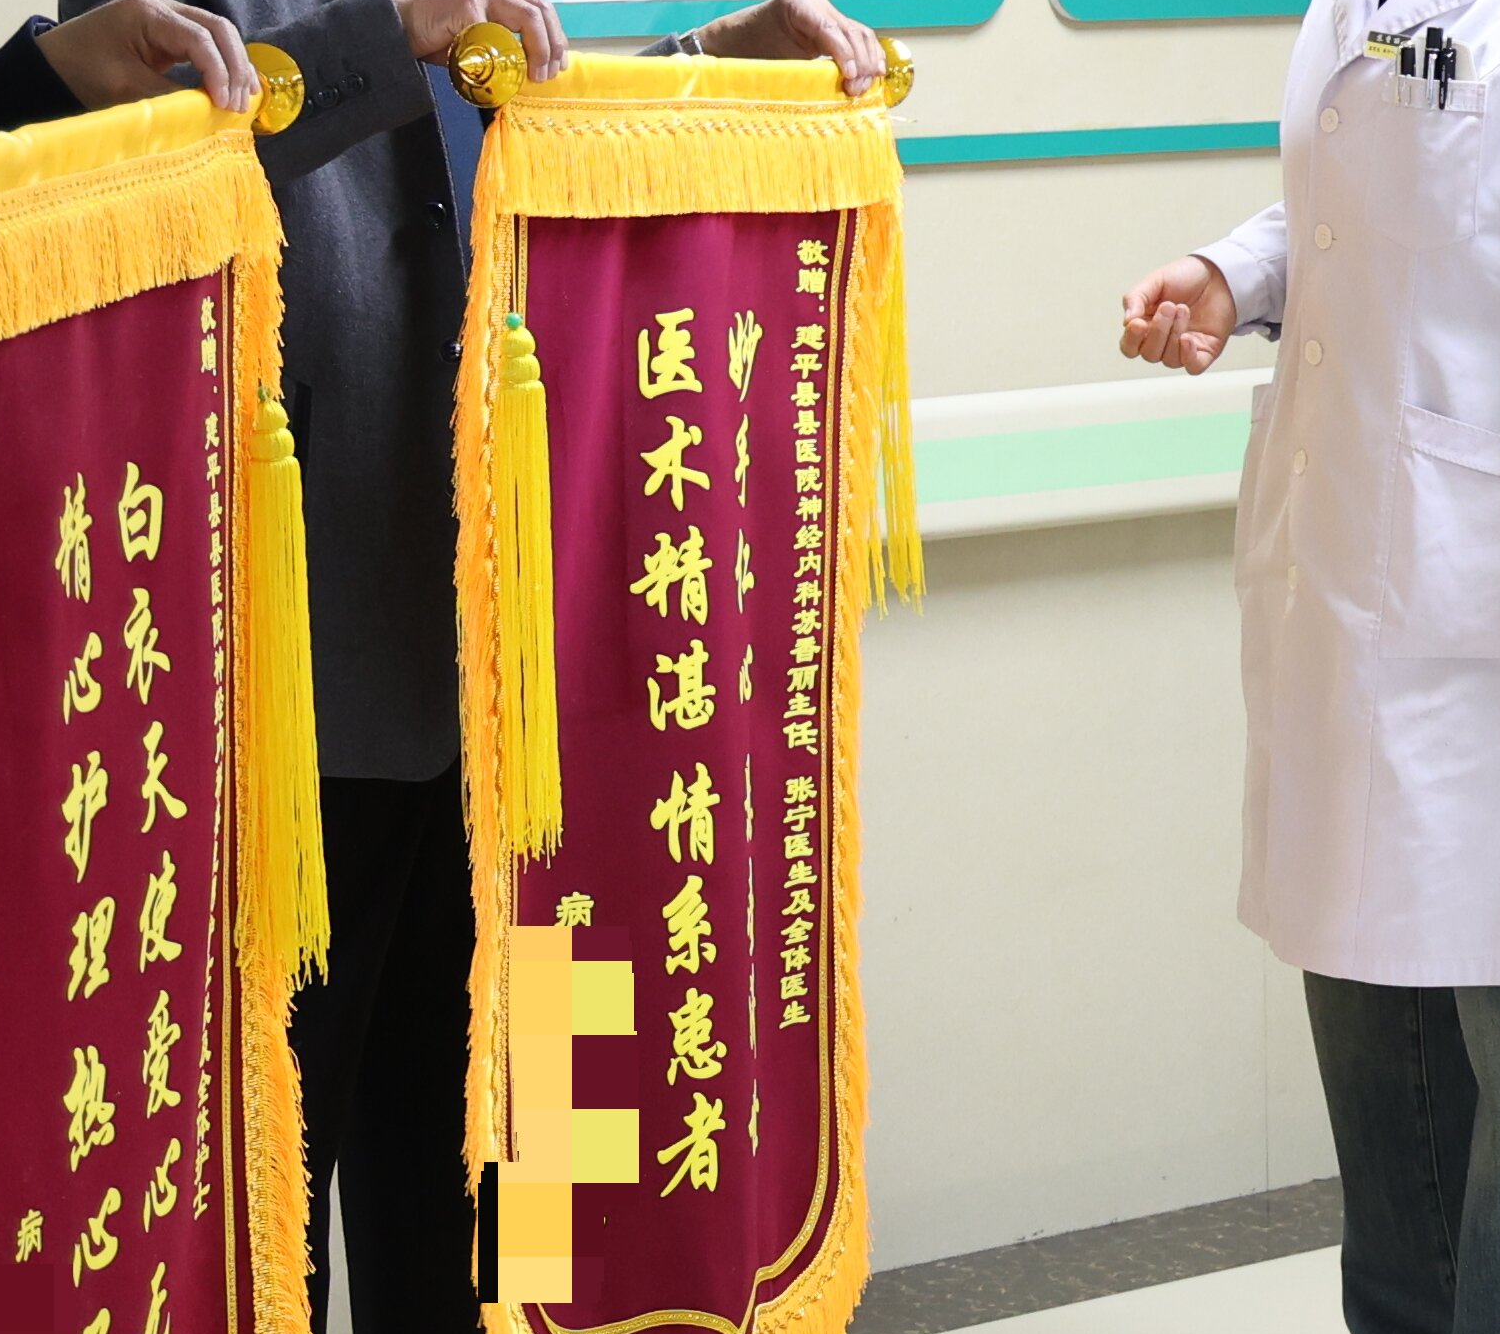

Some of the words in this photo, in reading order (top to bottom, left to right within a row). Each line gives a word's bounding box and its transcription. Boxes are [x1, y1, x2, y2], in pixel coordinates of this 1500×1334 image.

[629, 307, 728, 1198] 医术精湛情系患者
